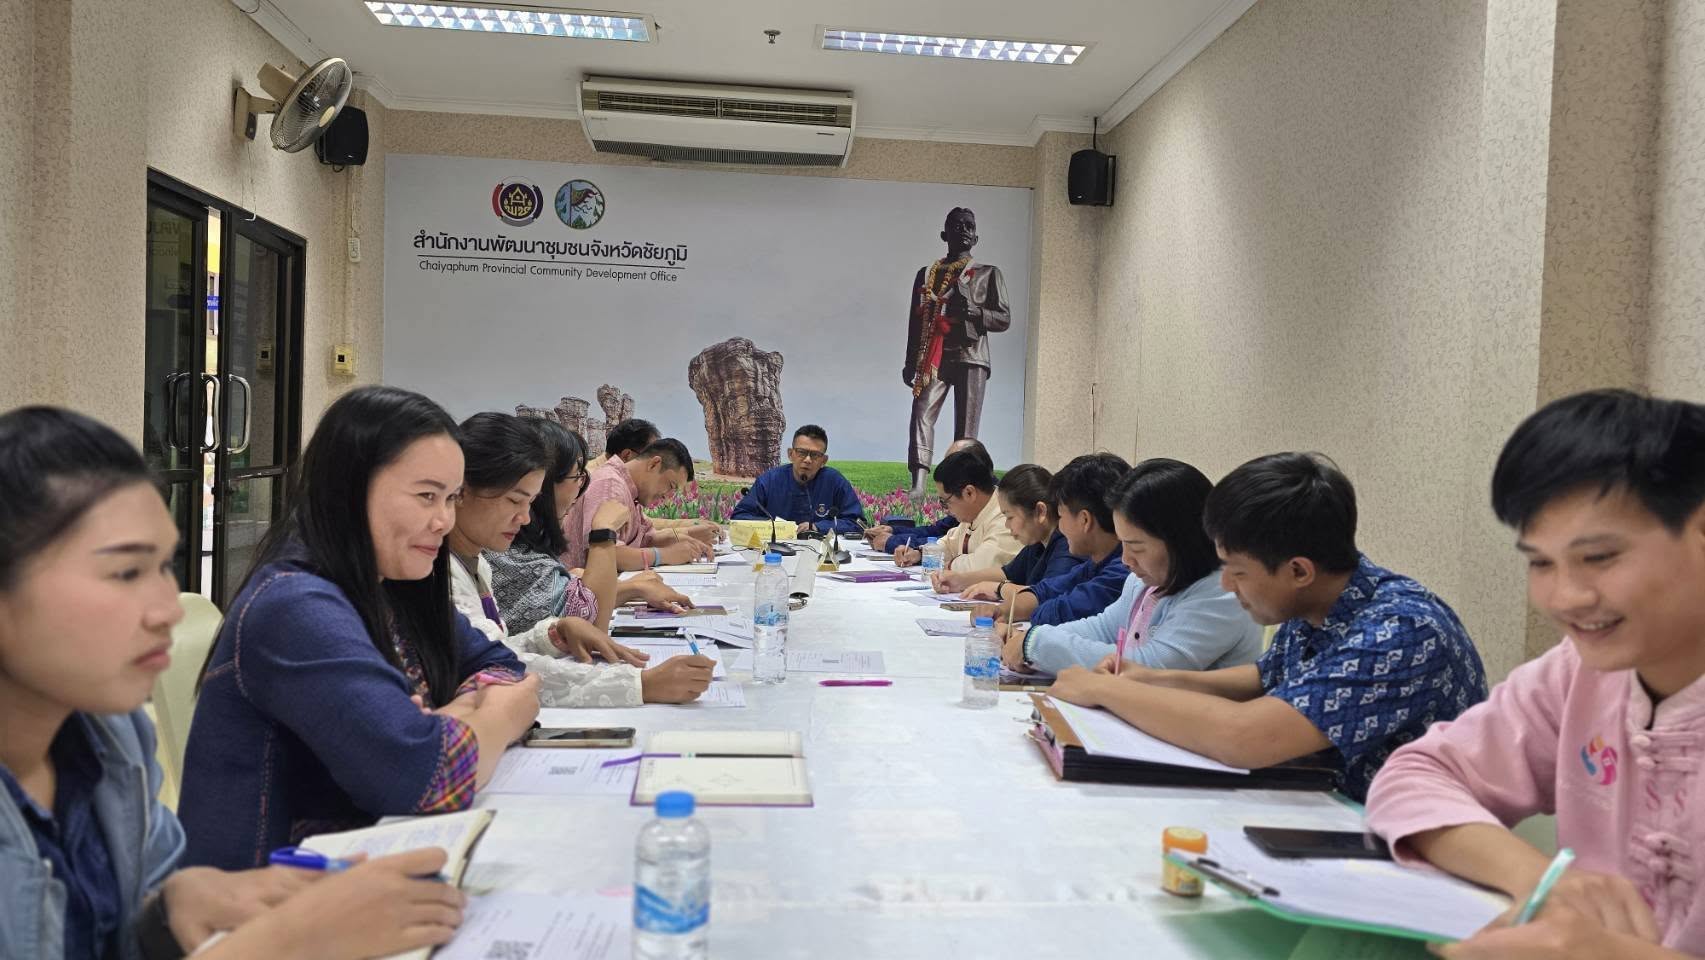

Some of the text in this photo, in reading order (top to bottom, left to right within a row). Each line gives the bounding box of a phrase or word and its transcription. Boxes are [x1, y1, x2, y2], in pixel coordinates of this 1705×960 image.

[413, 229, 688, 266] สำนักงานพัฒนาชุมชนจังหวัดชัยภูมิ
[419, 260, 677, 282] Chaiyaphum Provincial Community Development Office
